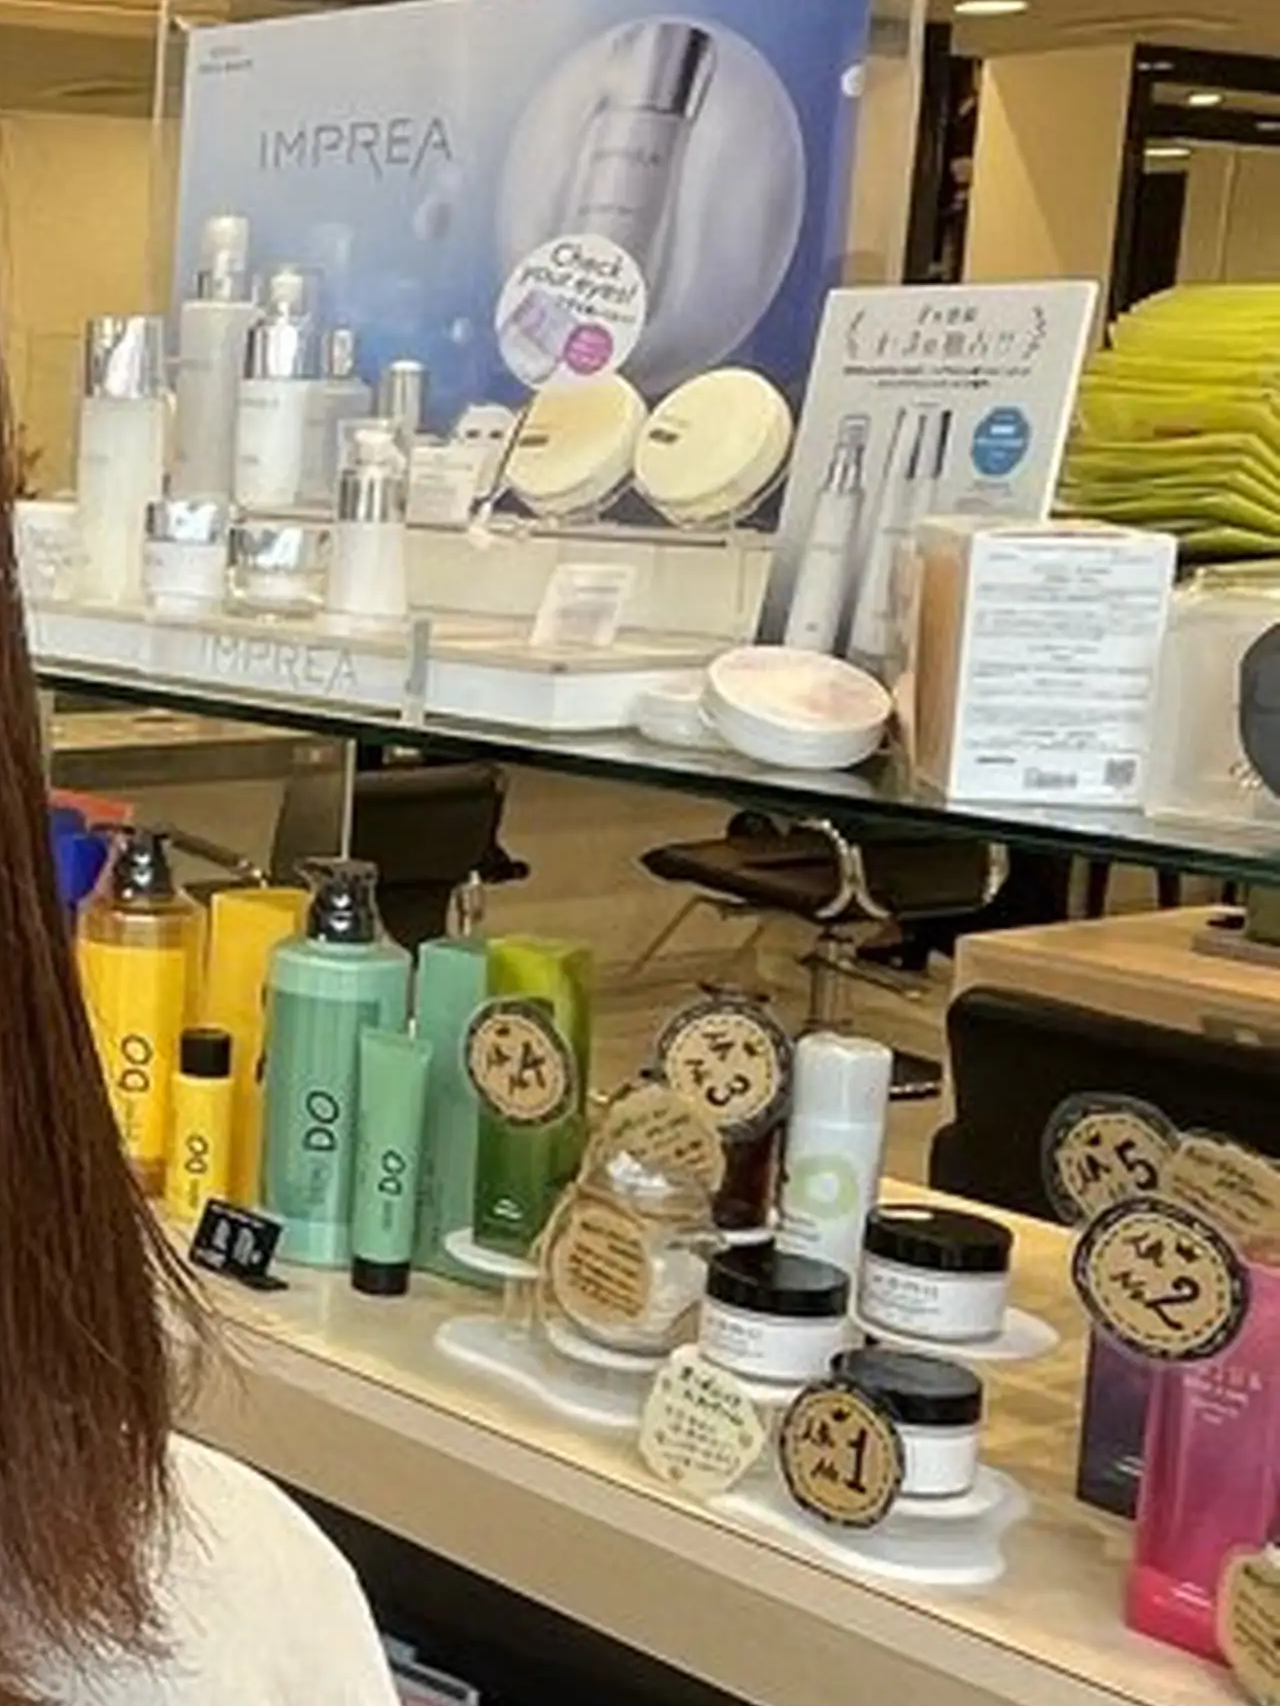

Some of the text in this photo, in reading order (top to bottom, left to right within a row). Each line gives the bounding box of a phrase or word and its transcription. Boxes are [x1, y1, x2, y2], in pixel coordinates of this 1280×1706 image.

[258, 116, 454, 181] IMPREA
[518, 266, 573, 288] your
[549, 242, 624, 279] Check
[203, 635, 360, 695] IMPREA
[119, 1033, 153, 1094] DO
[302, 1090, 340, 1153] DO
[184, 1134, 209, 1175] DO
[377, 1149, 407, 1196] DO
[1114, 1138, 1159, 1191] 5
[1144, 1274, 1201, 1331] 2
[843, 1424, 869, 1496] 1
